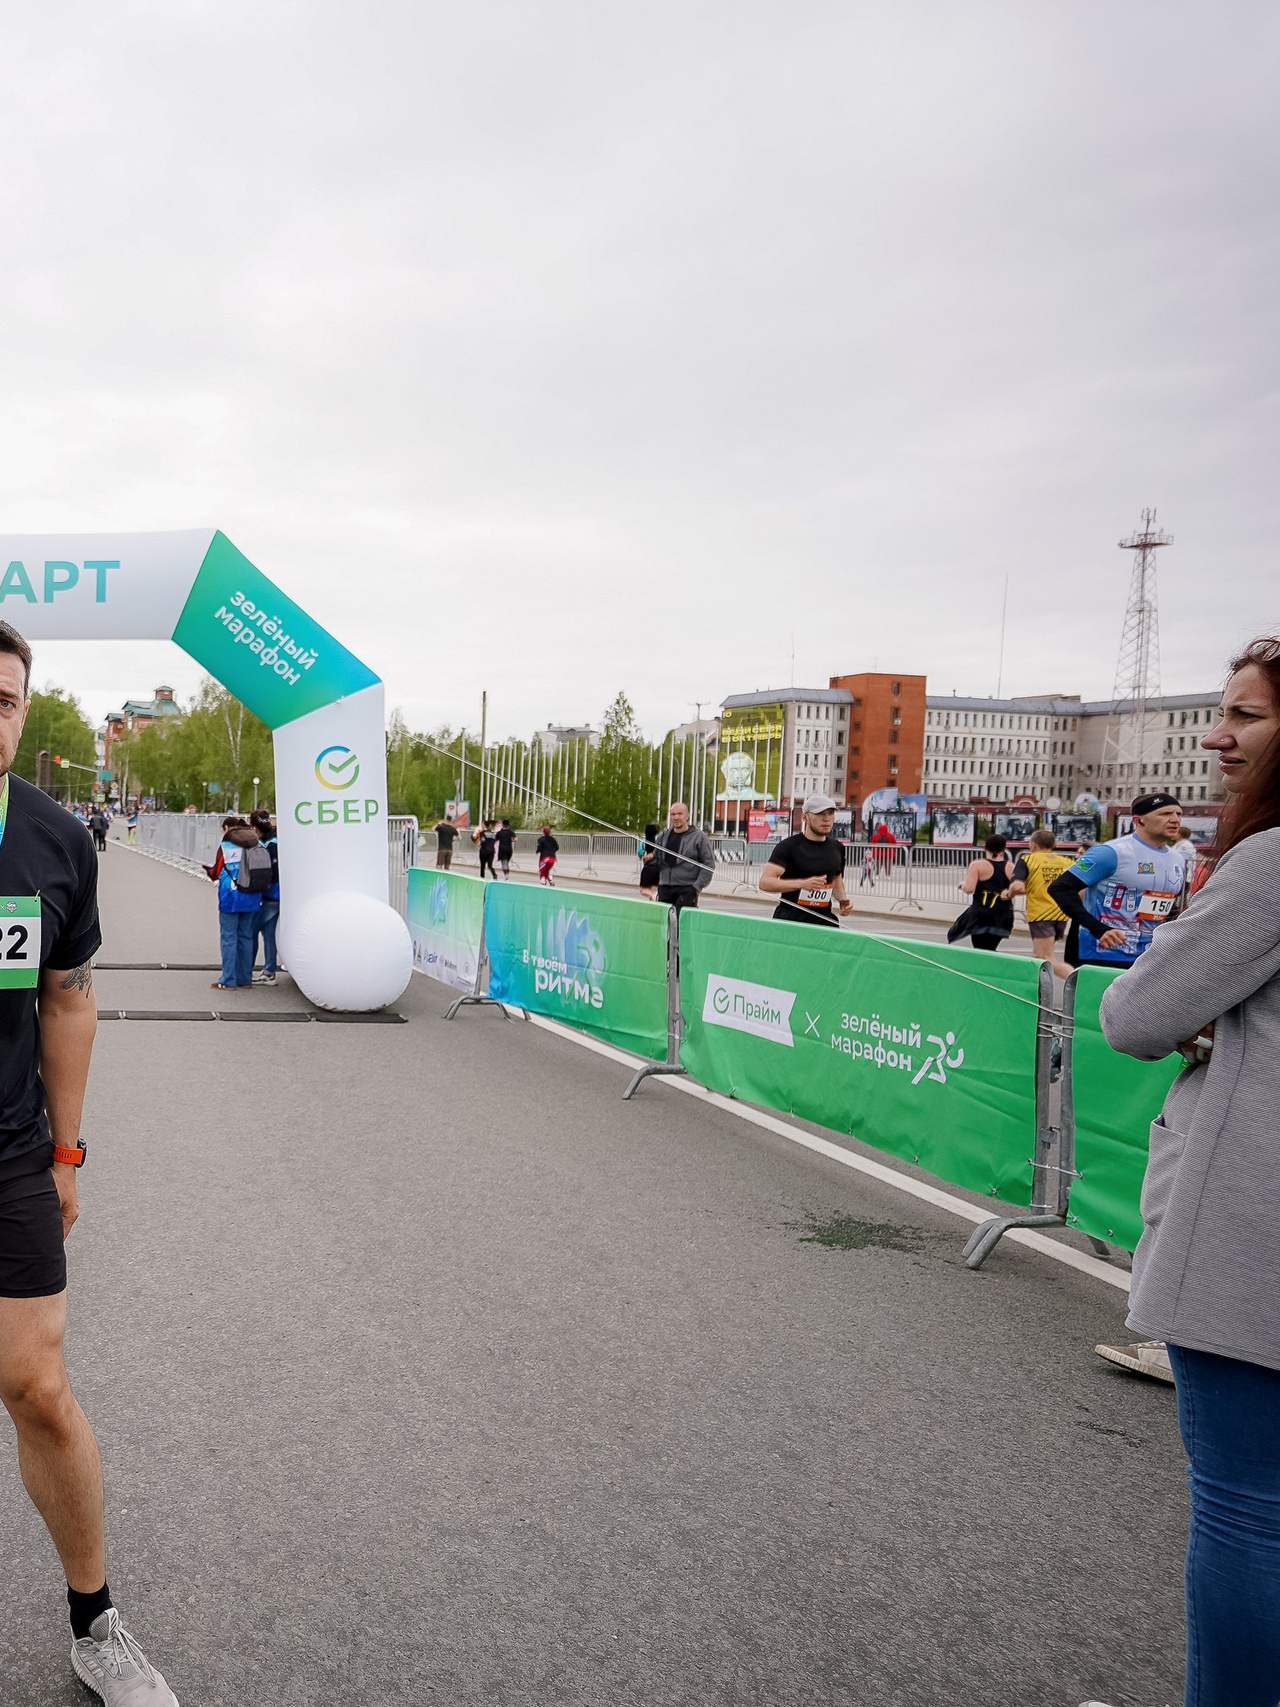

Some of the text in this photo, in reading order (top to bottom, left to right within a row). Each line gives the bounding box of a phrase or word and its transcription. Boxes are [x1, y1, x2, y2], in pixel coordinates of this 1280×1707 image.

[213, 605, 302, 687] марафон
[229, 590, 319, 671] зелёный
[294, 799, 379, 826] СБЕР
[522, 948, 567, 974] В твоём
[733, 994, 781, 1025] Прайм
[840, 1012, 921, 1048] зелёный
[831, 1033, 912, 1072] марафон
